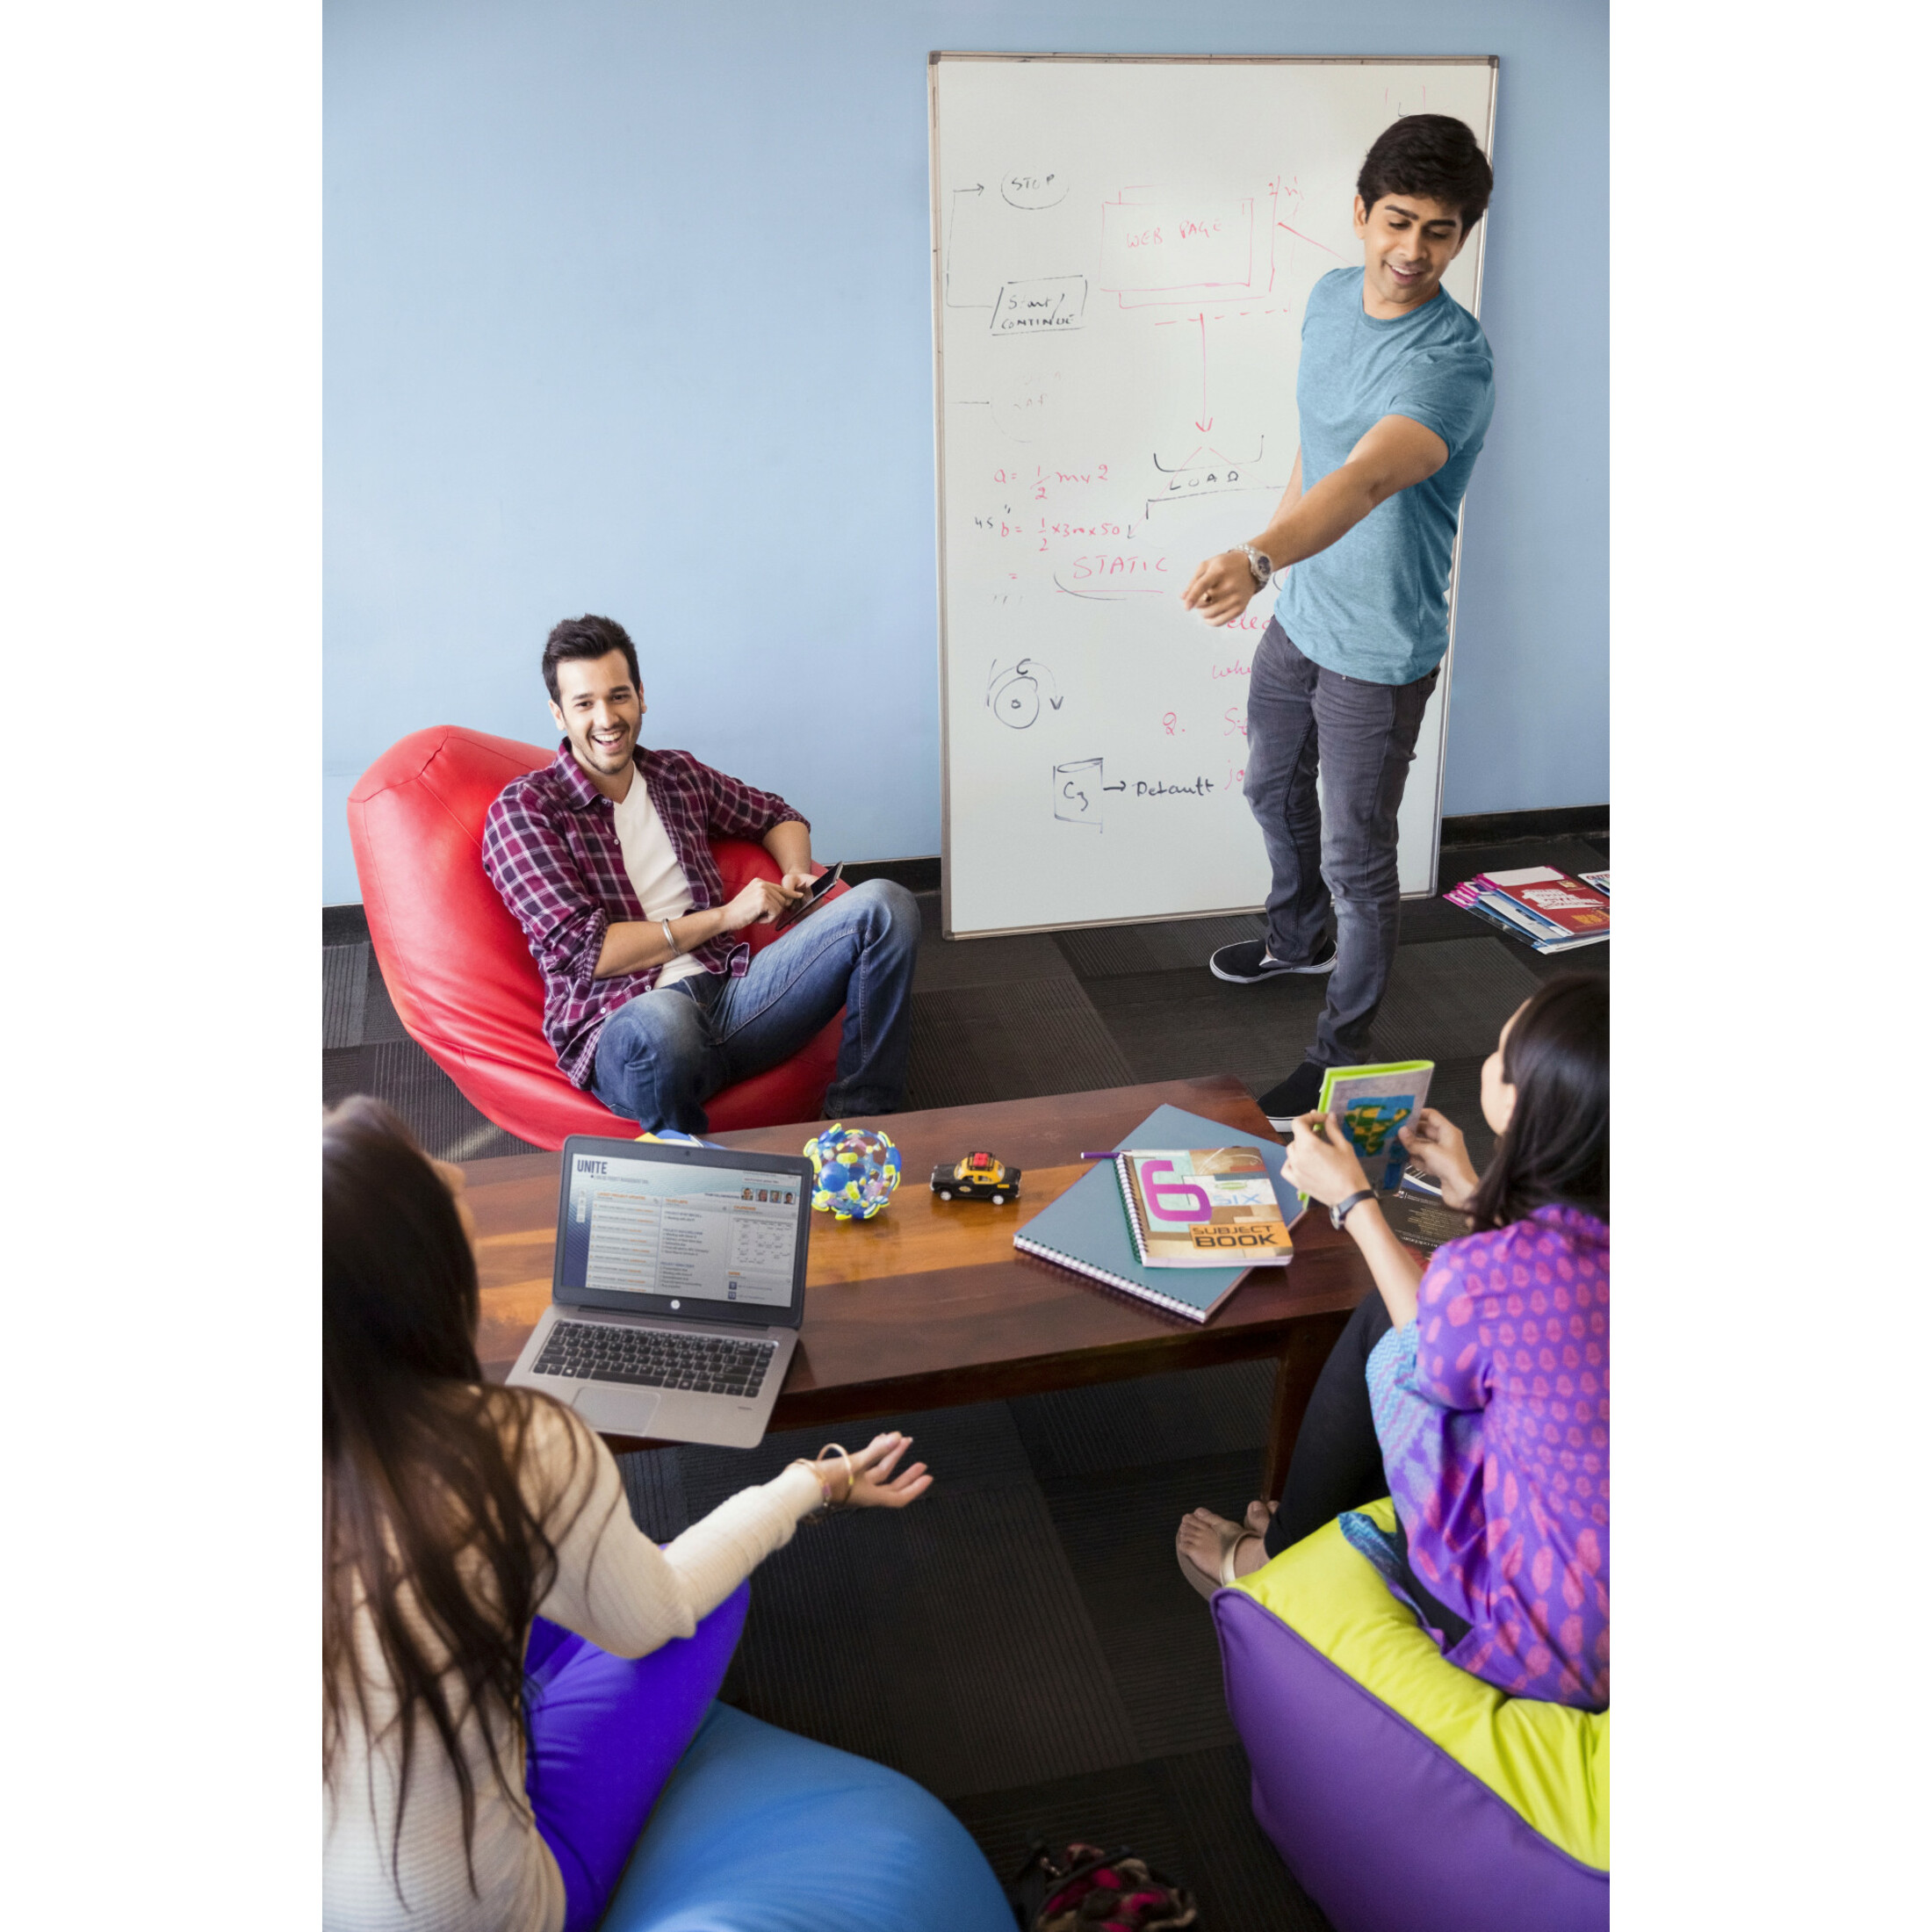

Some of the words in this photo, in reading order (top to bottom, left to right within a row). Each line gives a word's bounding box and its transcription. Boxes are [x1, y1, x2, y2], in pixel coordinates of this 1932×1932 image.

[1127, 227, 1163, 249] WEB
[1179, 219, 1222, 240] PAGE
[1001, 314, 1075, 329] CONTINUE
[1170, 470, 1239, 490] LOAD
[1072, 554, 1169, 580] STATIC
[1141, 1159, 1213, 1222] 6
[1212, 1193, 1264, 1206] SIX
[1193, 1225, 1272, 1236] SUBJECT
[1195, 1233, 1279, 1248] BOOK
